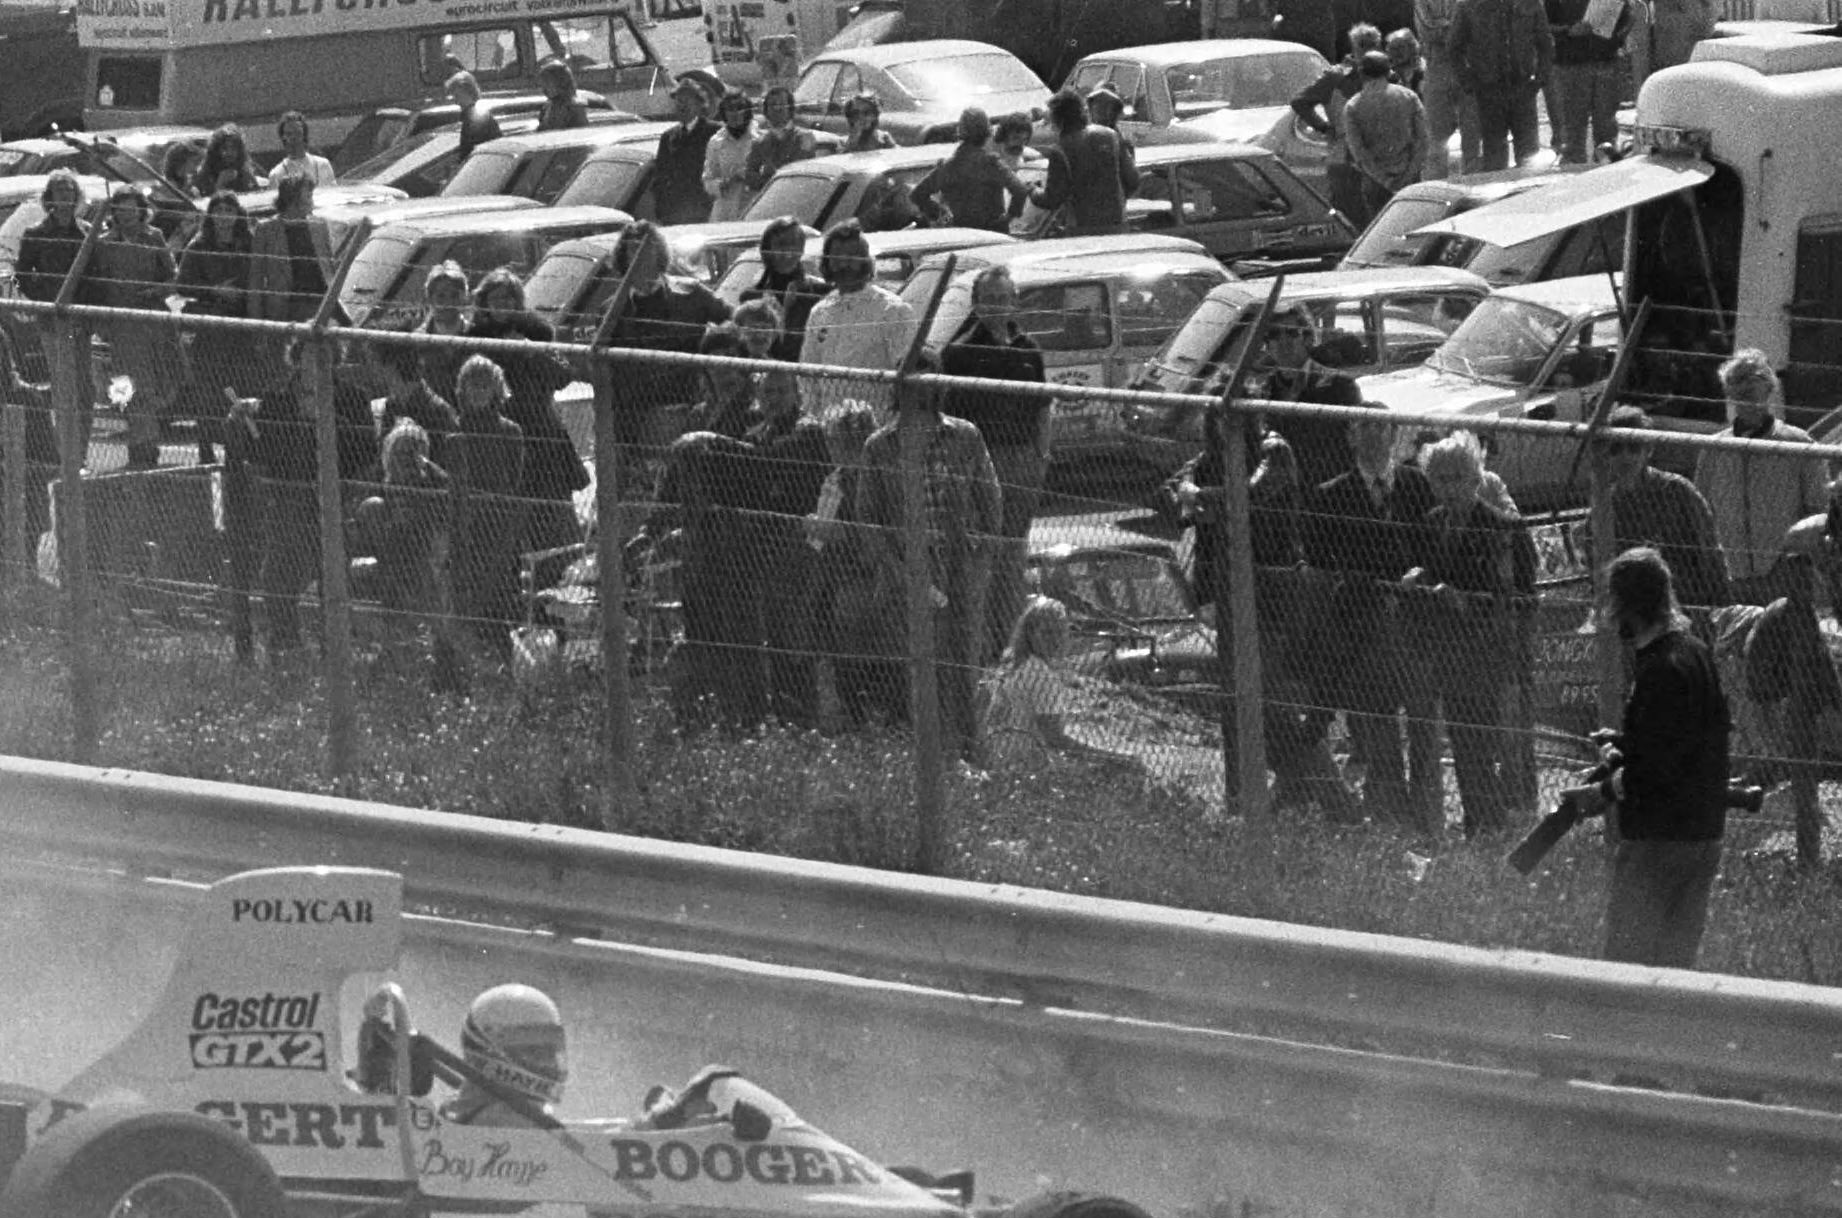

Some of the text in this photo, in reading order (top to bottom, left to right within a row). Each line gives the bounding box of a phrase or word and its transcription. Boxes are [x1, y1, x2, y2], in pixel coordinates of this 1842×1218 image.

[232, 899, 373, 924] POLYCAR
[192, 992, 321, 1031] Castrol
[193, 1033, 324, 1068] GTX2
[612, 1139, 884, 1185] BOOGER
